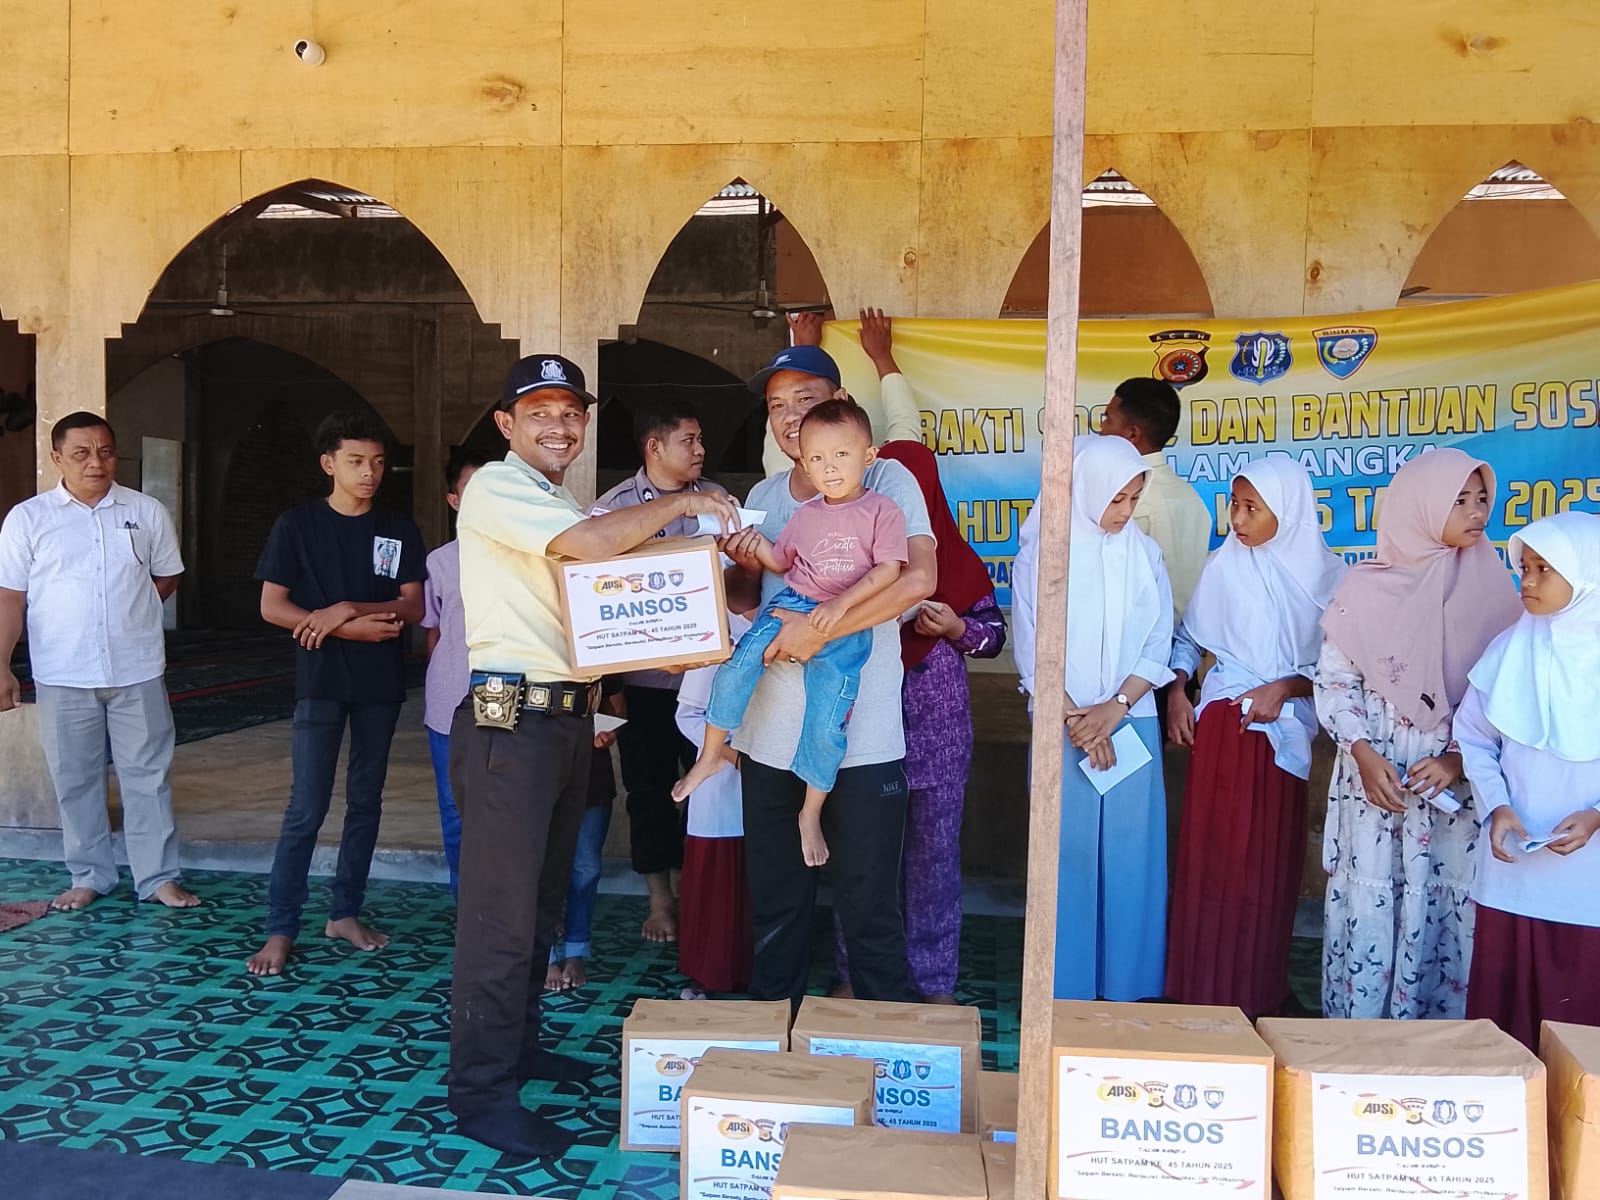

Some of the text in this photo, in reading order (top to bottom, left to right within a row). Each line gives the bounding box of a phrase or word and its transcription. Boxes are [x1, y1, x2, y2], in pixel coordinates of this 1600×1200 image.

[1190, 396, 1277, 446] DAN
[1291, 384, 1498, 442] BANTUAN
[1511, 379, 1600, 432] SOS
[919, 407, 1025, 455] BAKTI
[957, 499, 1035, 544] HUT
[811, 536, 858, 557] Create
[599, 595, 688, 622] BANSOS
[596, 632, 609, 641] HUT
[611, 629, 638, 639] SATPAM
[660, 624, 682, 633] TAHUN
[898, 1119, 921, 1127] TAHUN
[1101, 1117, 1224, 1144] BANSOS
[1357, 1133, 1485, 1159] BANSOS
[1090, 1157, 1108, 1165] HUT
[1111, 1158, 1150, 1167] SATPAM
[1181, 1161, 1211, 1170] TAHUN
[1213, 1162, 1233, 1170] 2025
[713, 1181, 728, 1189] HUT
[730, 1182, 759, 1191] SATPAM
[1347, 1172, 1365, 1180] HUT
[1368, 1173, 1407, 1182] SATPAM
[1440, 1176, 1472, 1184] TAHUN
[1474, 1176, 1495, 1184] 2025
